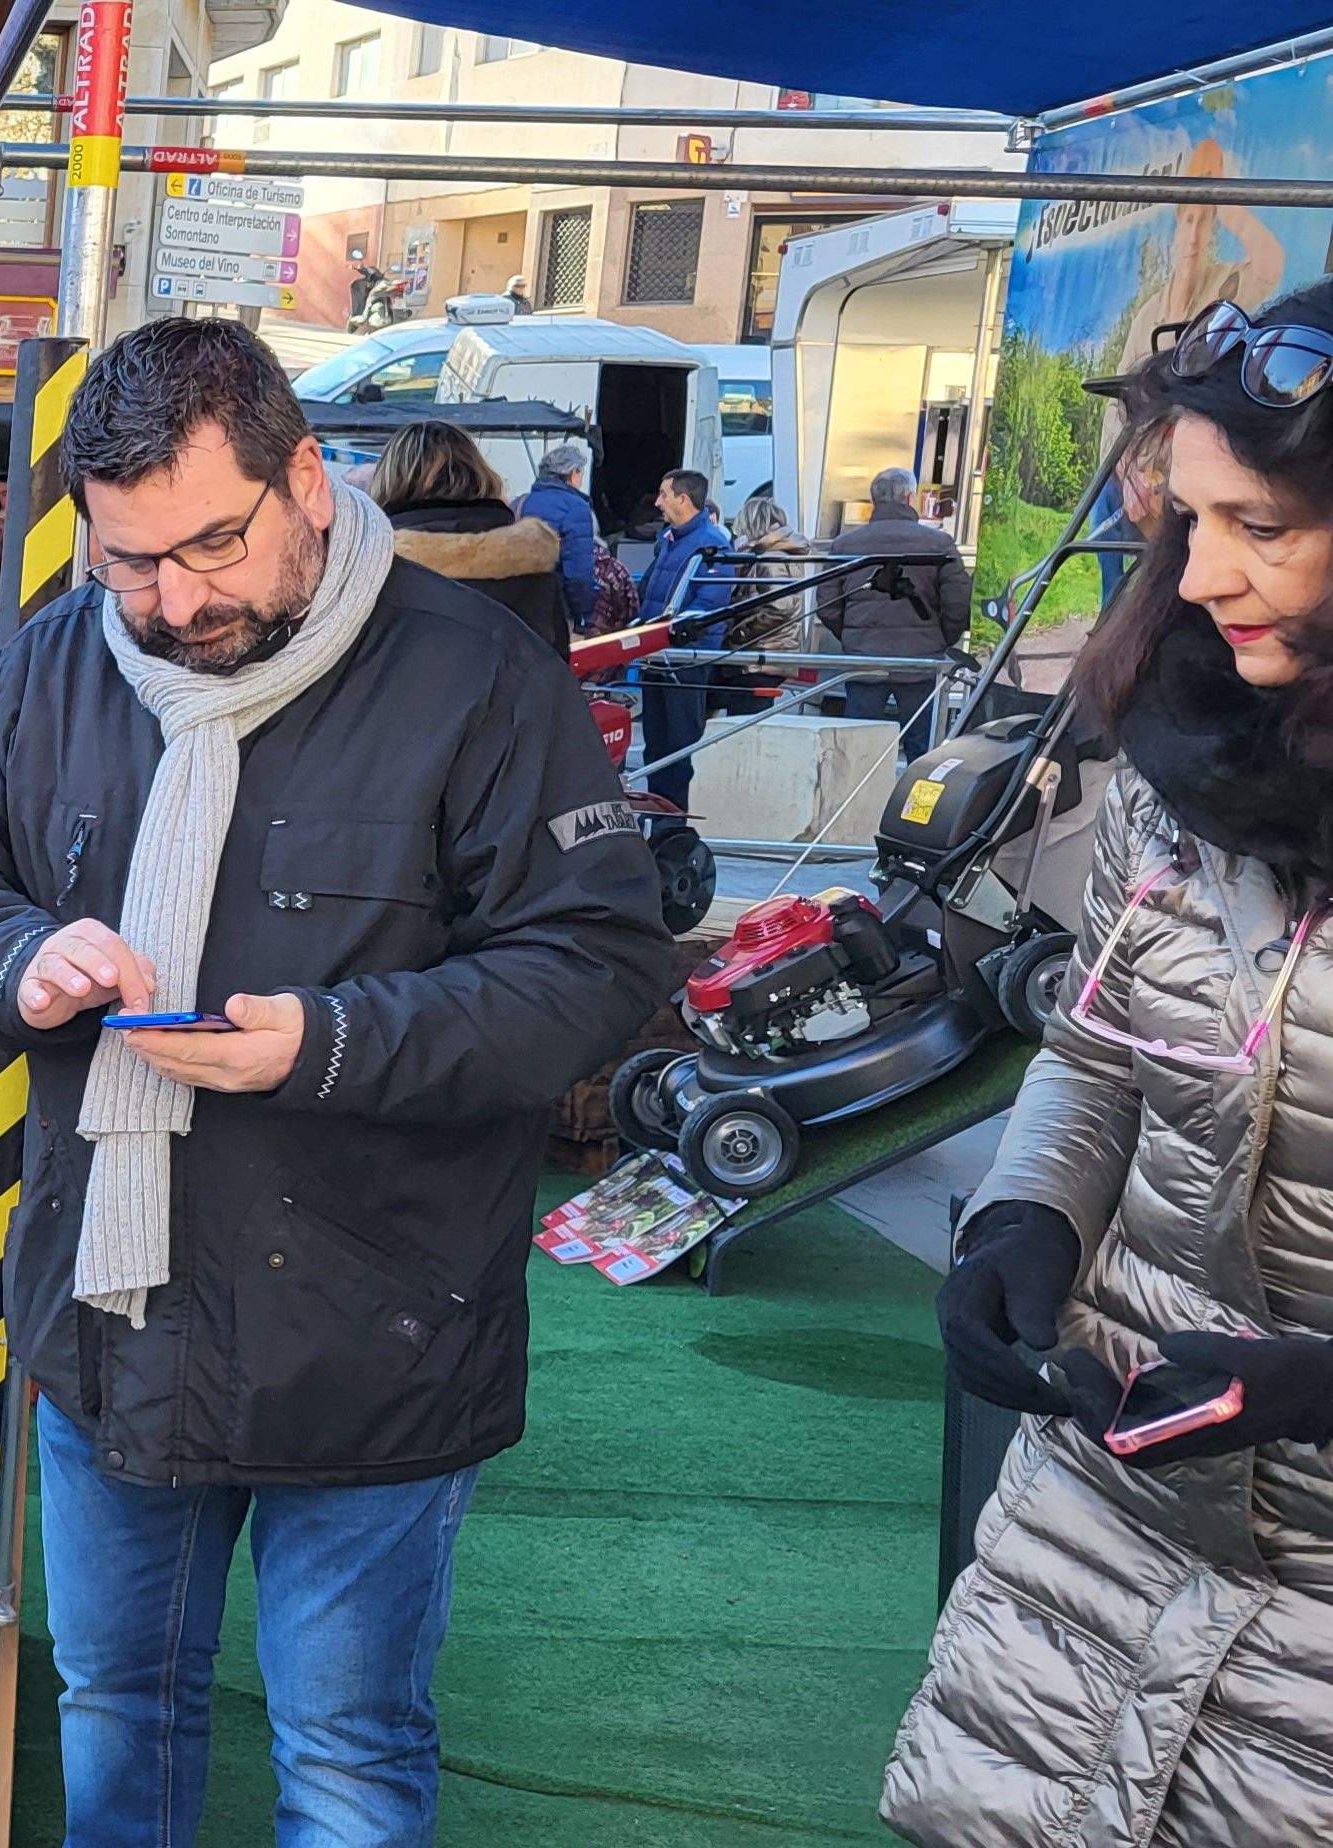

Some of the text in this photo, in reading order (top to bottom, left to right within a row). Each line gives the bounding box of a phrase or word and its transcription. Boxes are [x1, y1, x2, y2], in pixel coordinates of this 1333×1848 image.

[73, 7, 96, 131] ALTRAD
[71, 144, 83, 180] 2000
[153, 150, 218, 165] ALTRAD
[207, 180, 301, 205] Oficina de Turismo
[167, 205, 281, 231] Centro de Interpretación
[165, 225, 219, 245] Somontano
[161, 252, 240, 273] Museo del Vino
